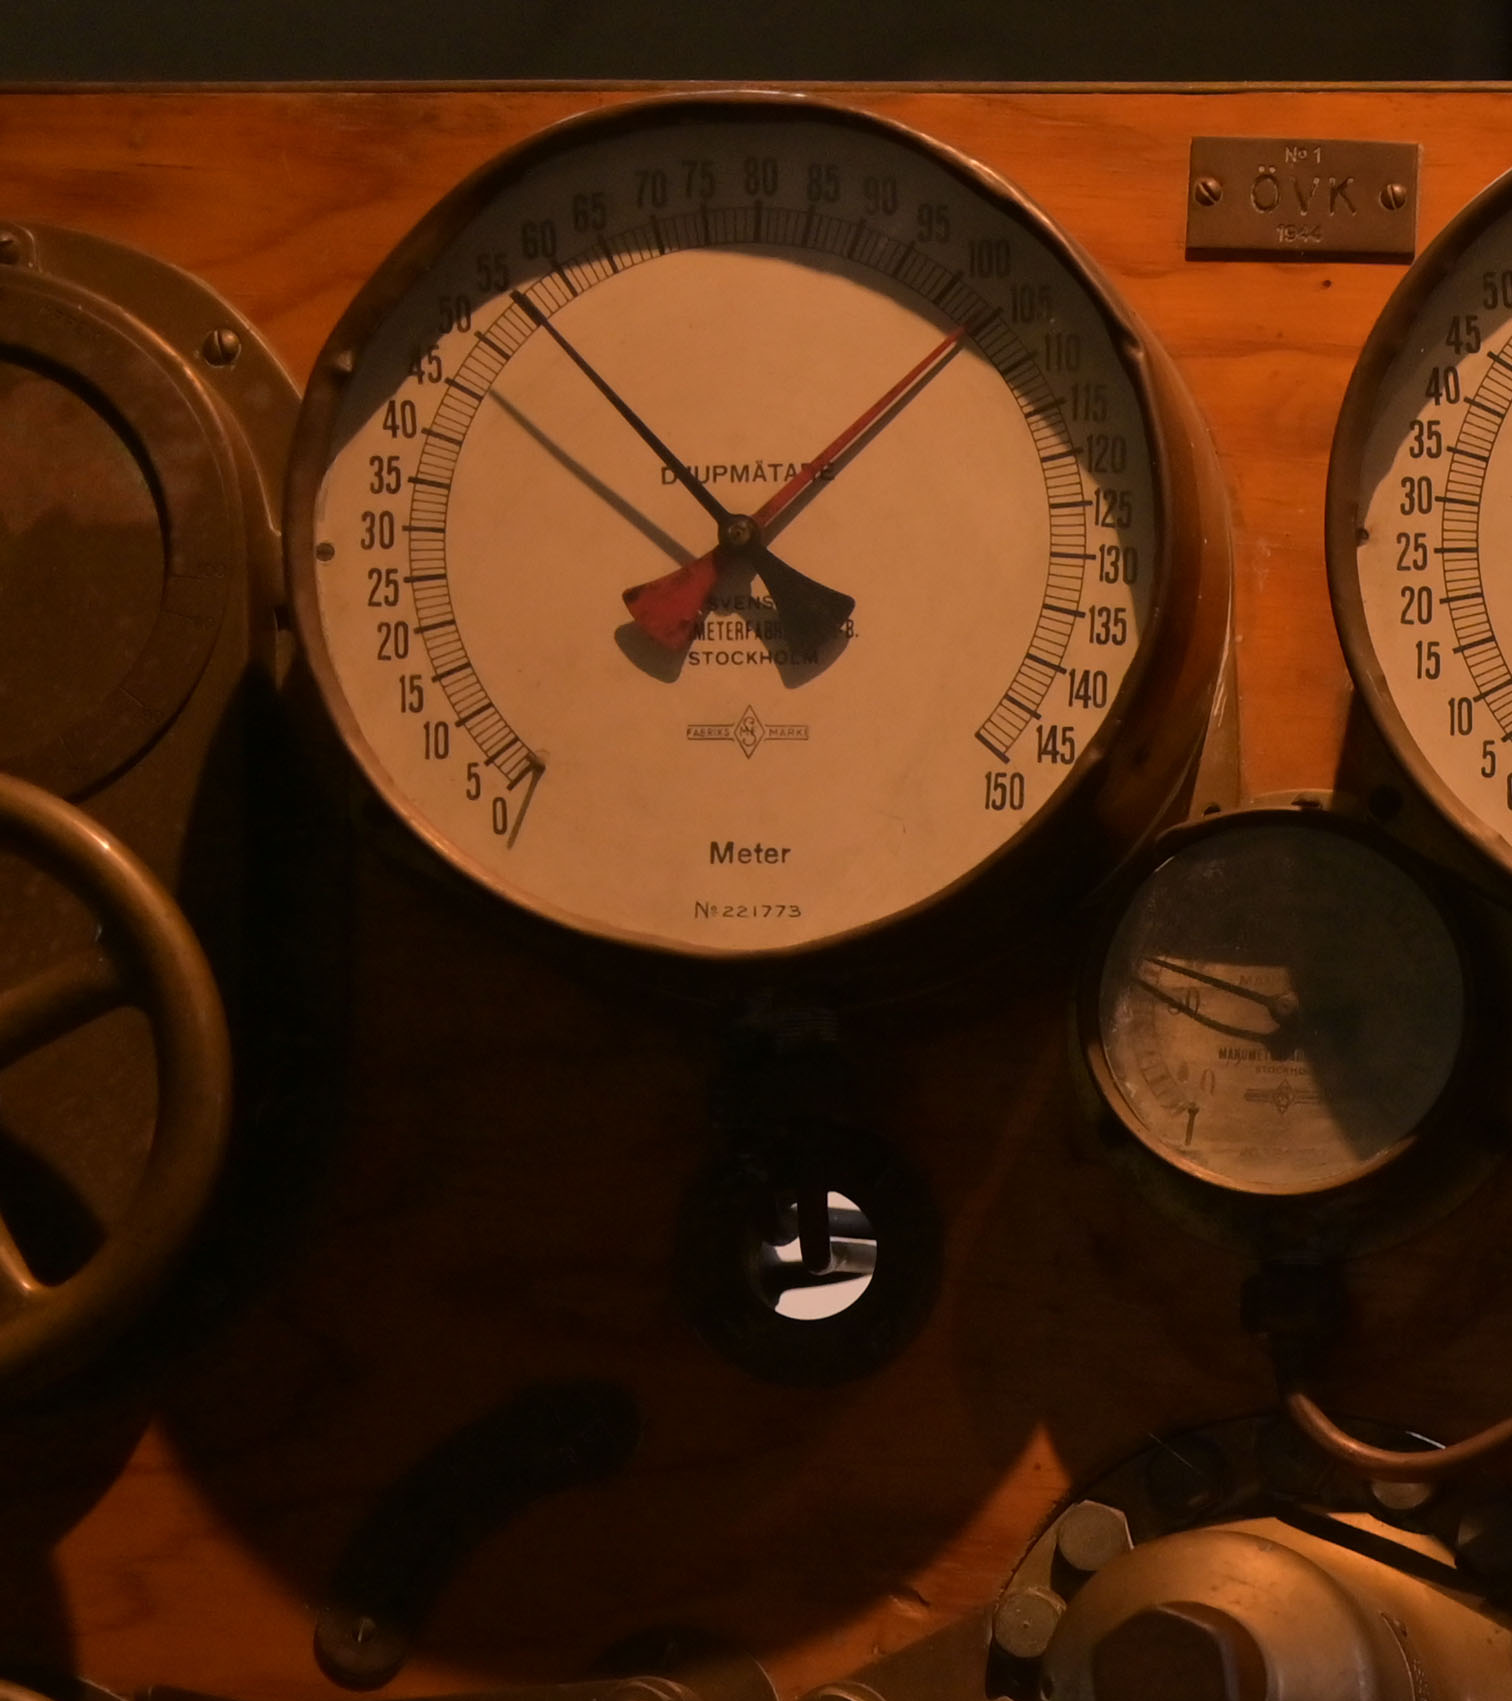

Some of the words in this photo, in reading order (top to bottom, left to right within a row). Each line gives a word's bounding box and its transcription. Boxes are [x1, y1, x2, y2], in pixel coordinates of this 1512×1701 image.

[738, 151, 779, 197] 80
[1250, 166, 1357, 216] ÖVK
[571, 191, 607, 233] 65
[1276, 224, 1323, 243] 1944
[382, 400, 419, 439] 40
[1086, 429, 1133, 475] 120
[369, 455, 402, 495] 35
[360, 510, 395, 551] 30
[1396, 531, 1428, 572] 25
[367, 567, 400, 608] 25
[1400, 585, 1433, 626] 20
[376, 620, 409, 662] 20
[1088, 604, 1127, 647] 135
[688, 650, 820, 667] STOCKHOLM
[1415, 639, 1441, 681] 15
[984, 770, 1025, 812] 150
[709, 840, 792, 865] Meter
